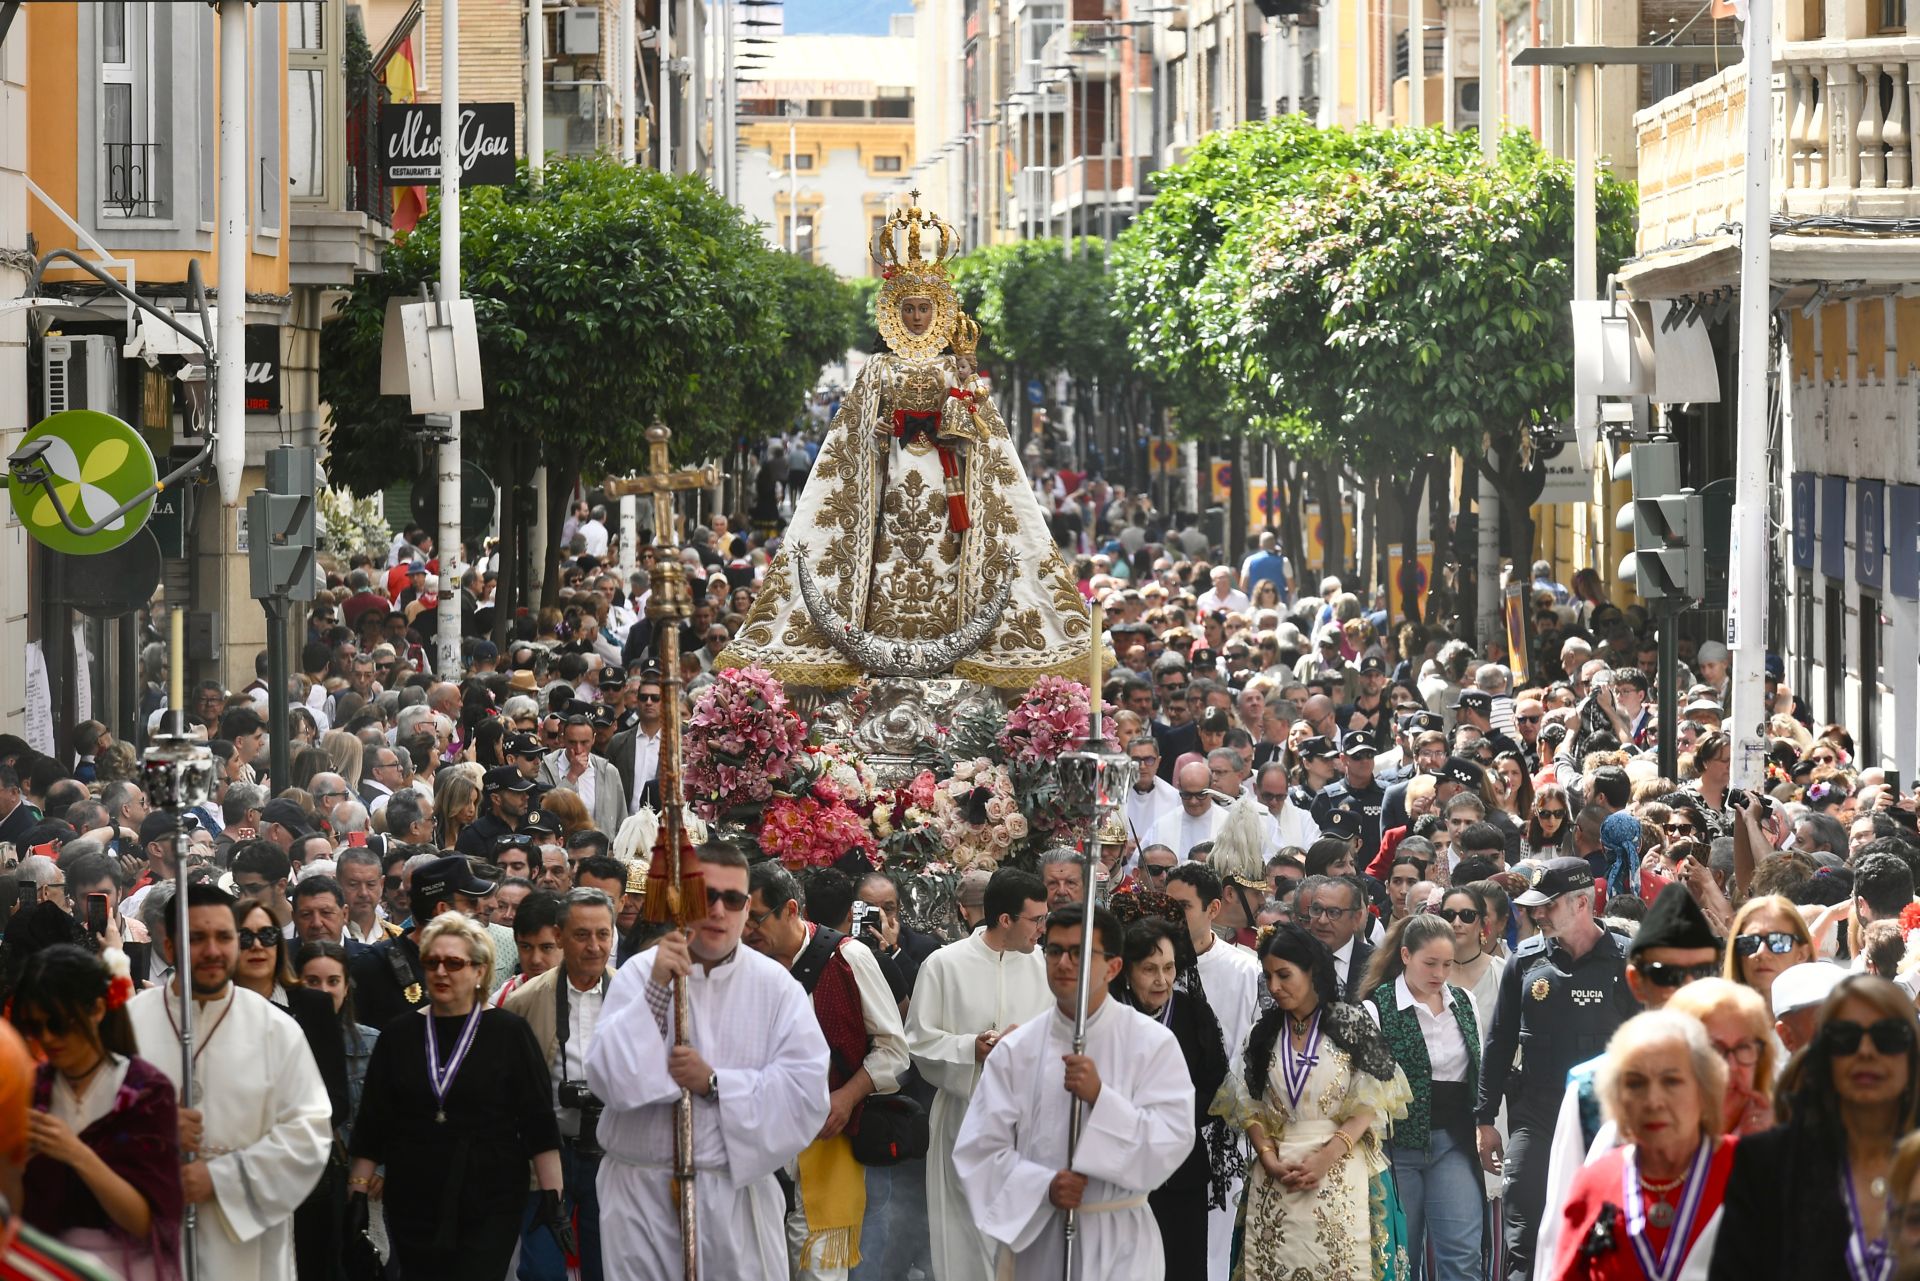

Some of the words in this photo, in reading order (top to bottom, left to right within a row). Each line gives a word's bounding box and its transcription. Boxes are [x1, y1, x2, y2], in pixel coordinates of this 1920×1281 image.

[774, 81, 816, 97] JUAN
[822, 81, 875, 96] HOTEL
[392, 167, 431, 176] RESTAURANTE
[1571, 989, 1604, 999] POLICIA
